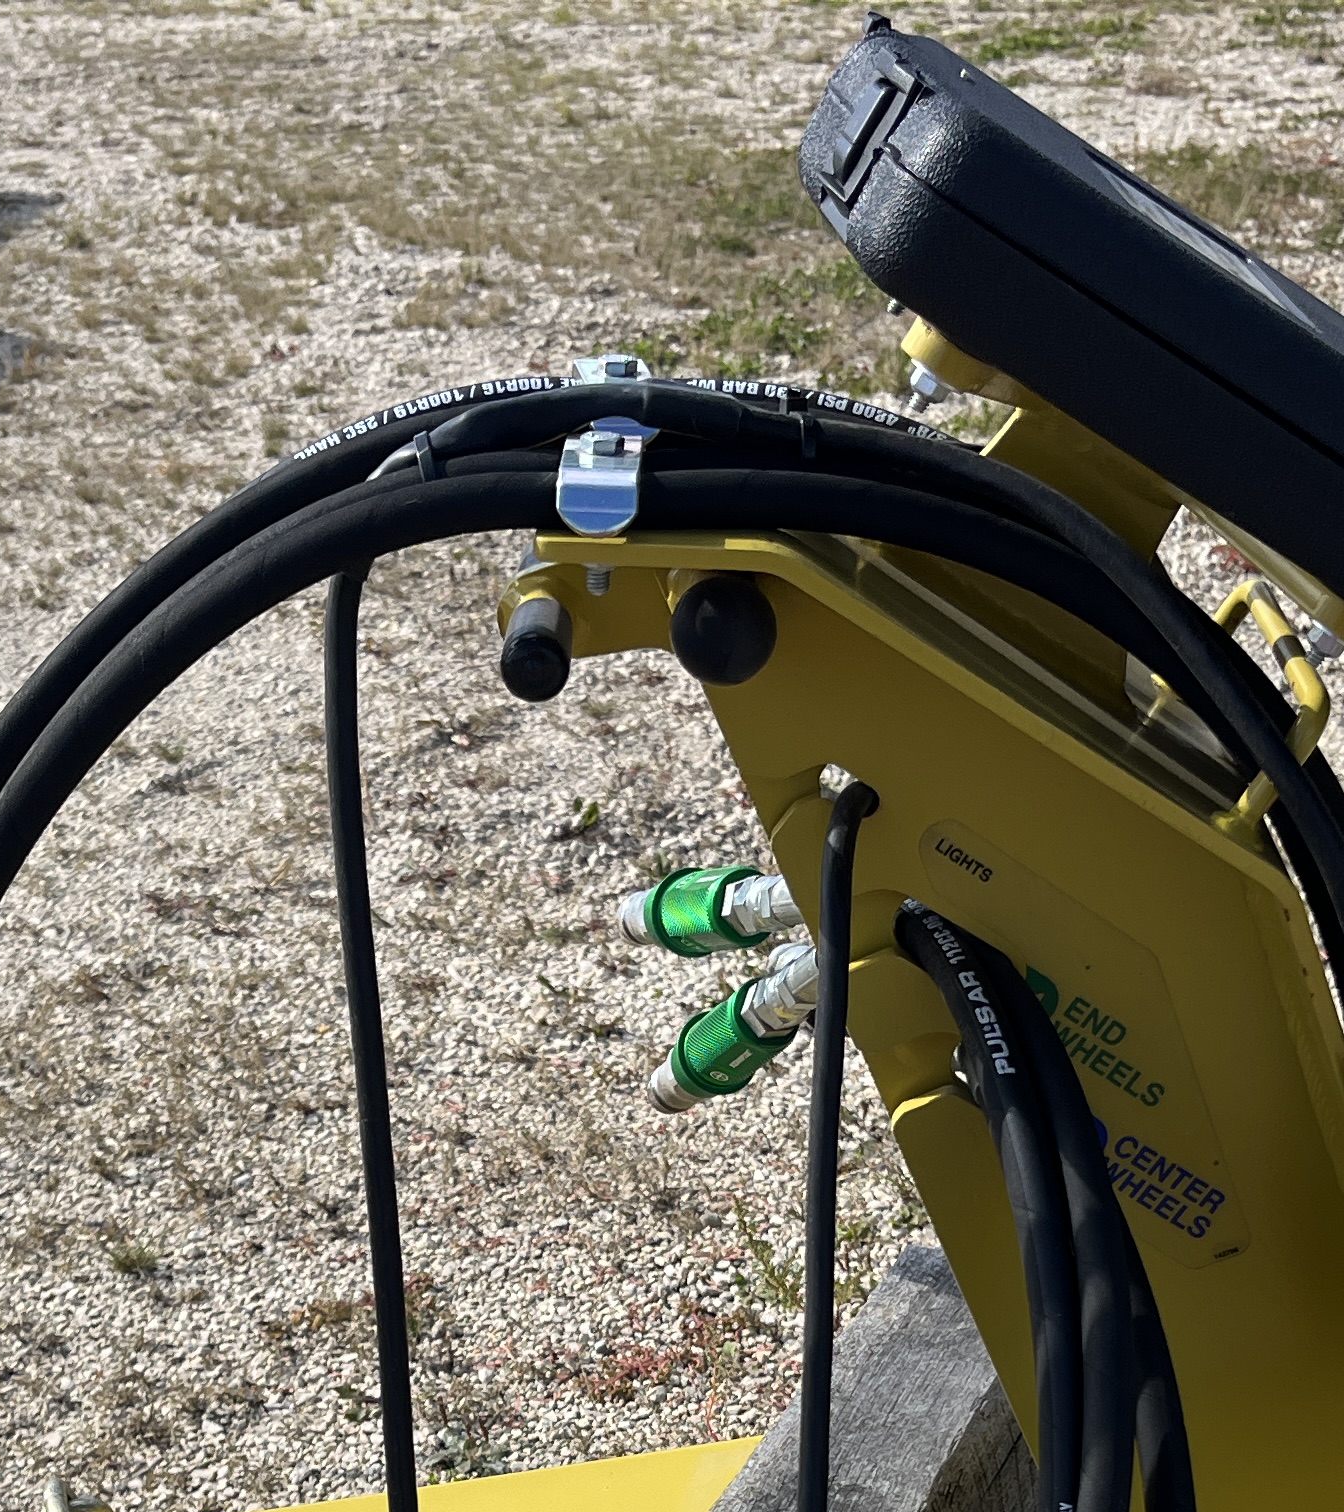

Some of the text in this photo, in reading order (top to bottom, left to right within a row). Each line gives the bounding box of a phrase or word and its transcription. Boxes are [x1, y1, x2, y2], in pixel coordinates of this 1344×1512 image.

[484, 378, 553, 395] 100R16
[722, 380, 758, 395] BAR
[394, 389, 464, 419] 100R19
[817, 393, 848, 411] PSI
[343, 417, 379, 440] 2SC
[935, 837, 994, 883] LIGHTS
[1063, 996, 1127, 1046] END
[1115, 1136, 1225, 1214] CENTER
